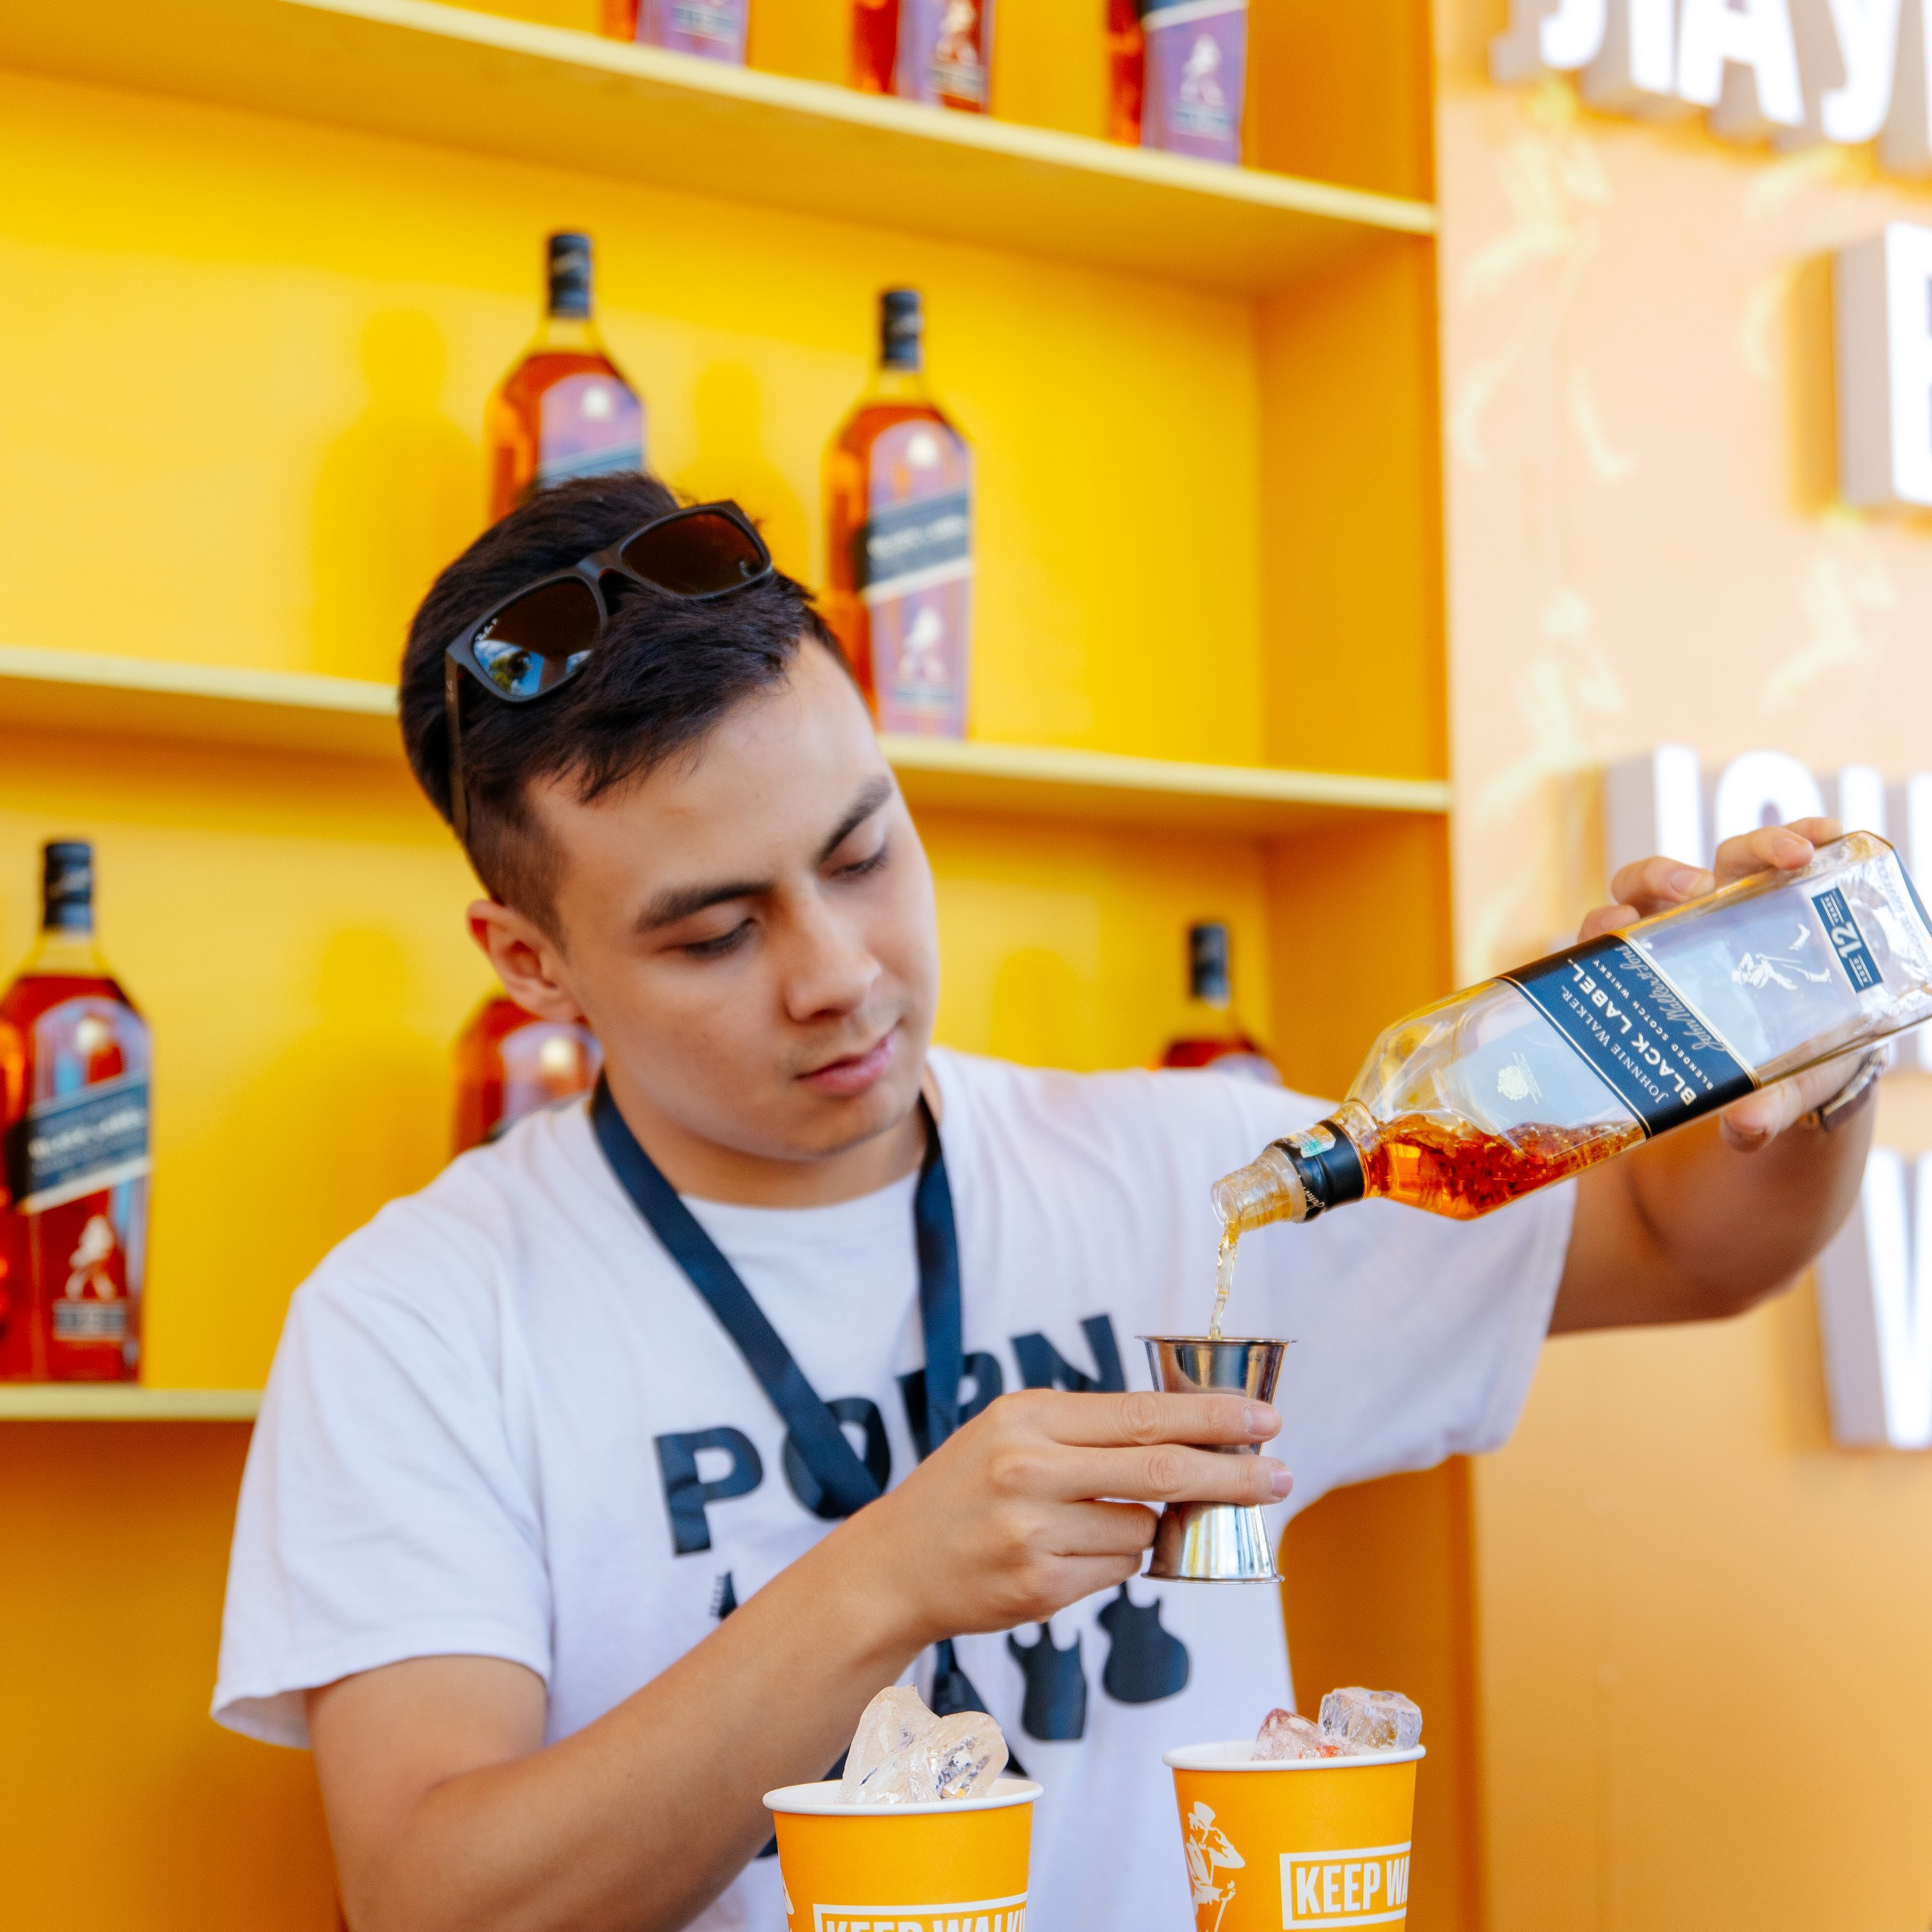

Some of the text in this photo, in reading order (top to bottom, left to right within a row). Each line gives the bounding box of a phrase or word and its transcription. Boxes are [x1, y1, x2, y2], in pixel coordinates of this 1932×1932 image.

[1829, 919, 1862, 959] 12
[1567, 961, 1697, 1106] BLACK LABEL
[1592, 958, 1713, 1091] BLENDED SCOTCH WHISKY
[1610, 1042, 1669, 1104] JOHNNIE
[1297, 1862, 1380, 1915] KEEP
